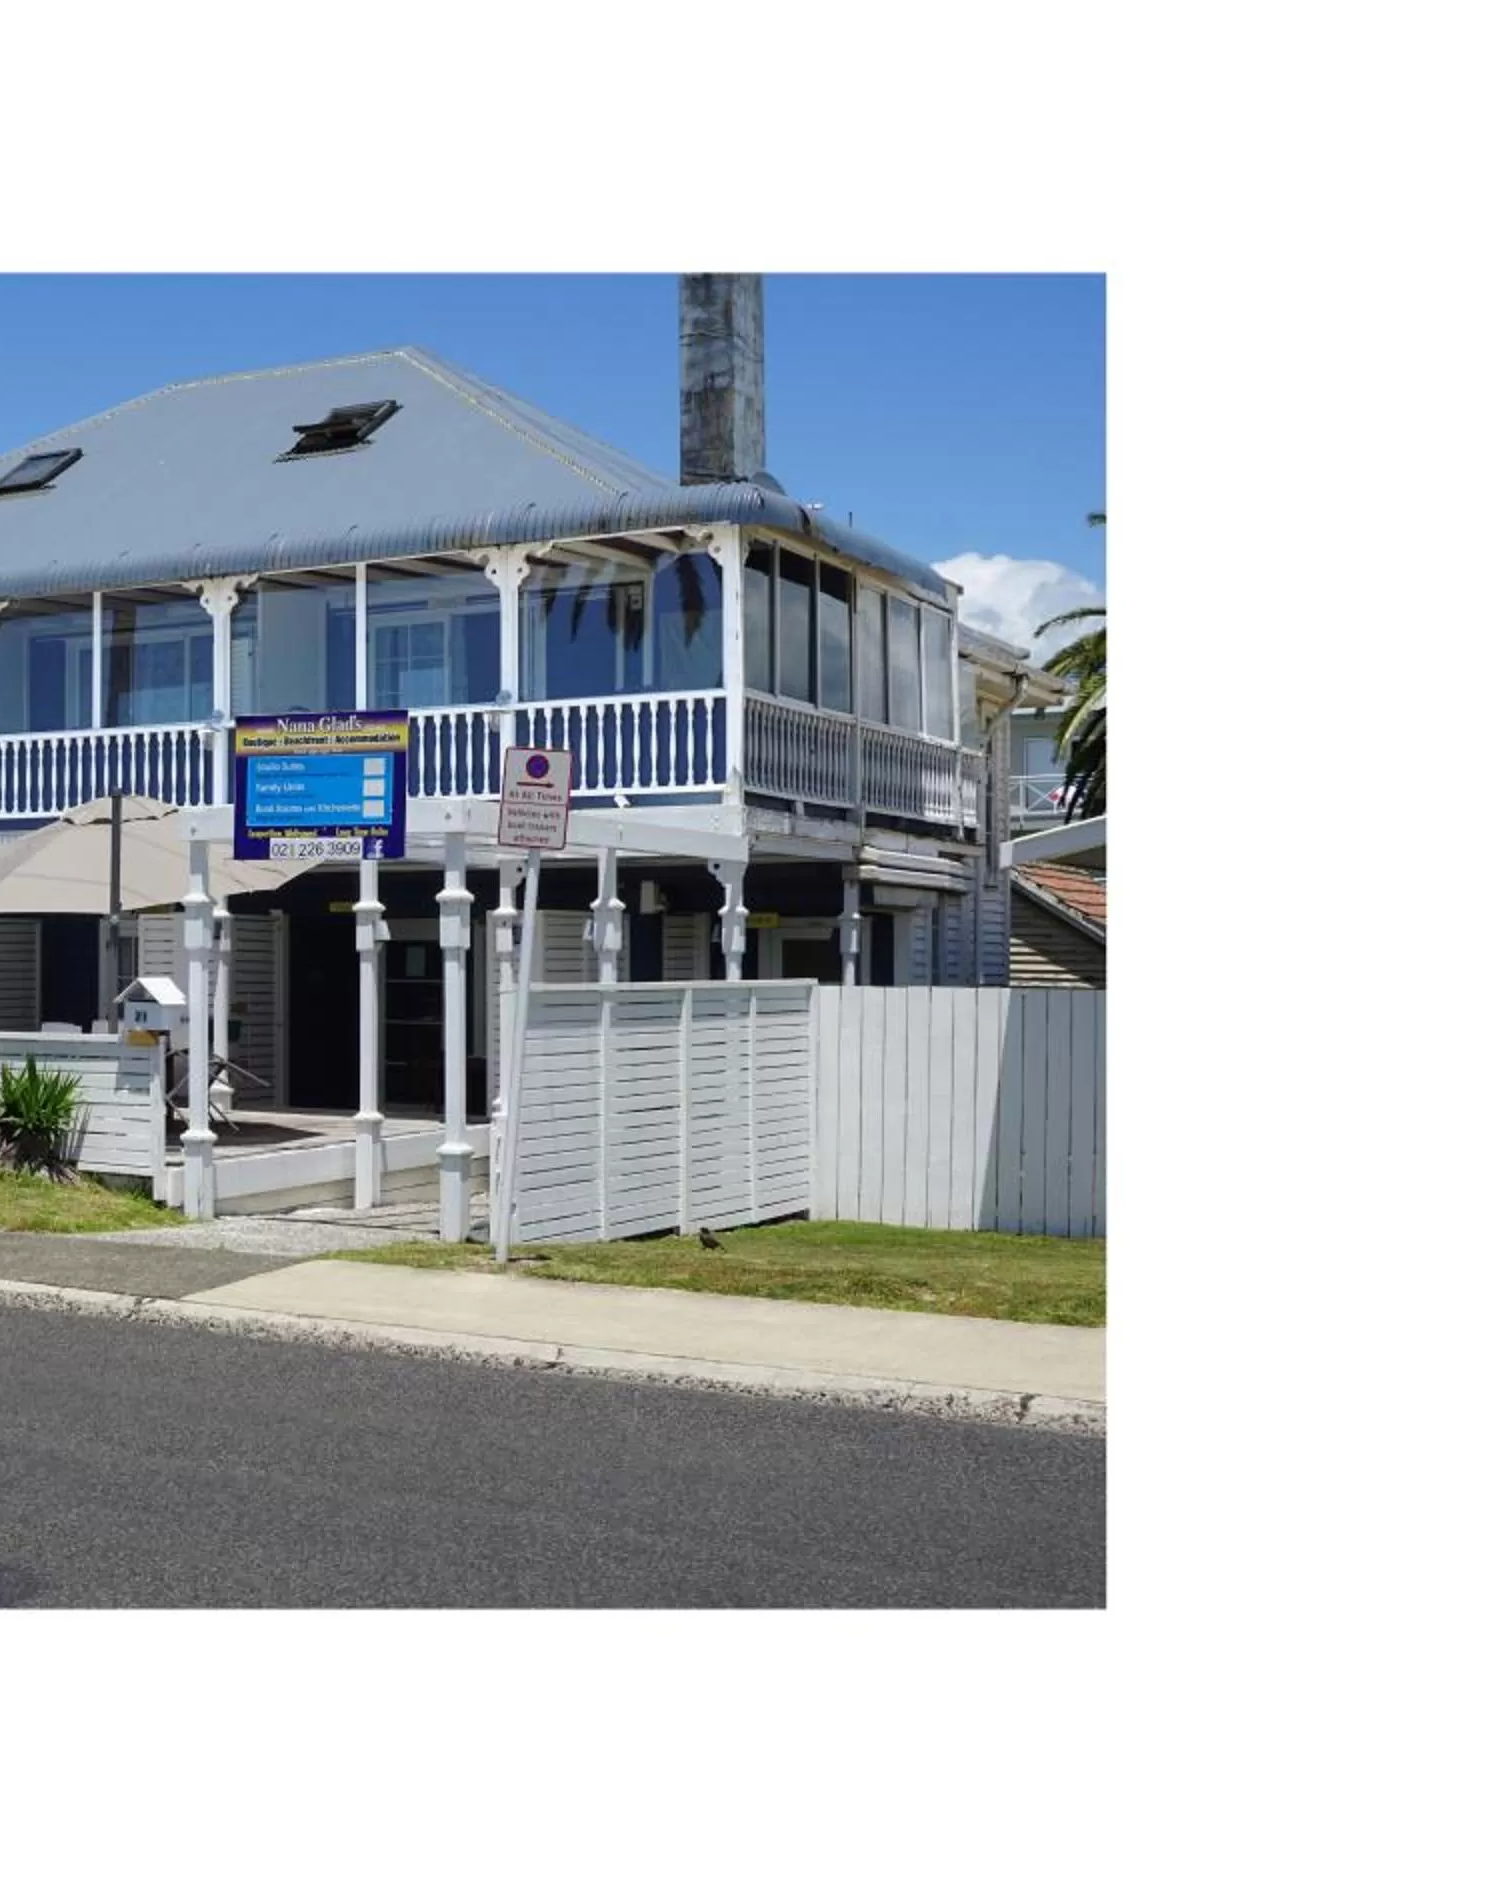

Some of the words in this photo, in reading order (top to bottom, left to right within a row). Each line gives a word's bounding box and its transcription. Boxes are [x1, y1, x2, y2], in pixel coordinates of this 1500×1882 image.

[277, 717, 315, 733] Nana
[319, 714, 362, 732] Glad's
[284, 735, 328, 745] Beachfront
[335, 733, 401, 743] Accommodation
[537, 791, 563, 801] Times
[271, 843, 295, 857] 021
[298, 842, 324, 857] 226
[327, 841, 361, 857] 3909
[134, 1009, 147, 1023] 21
